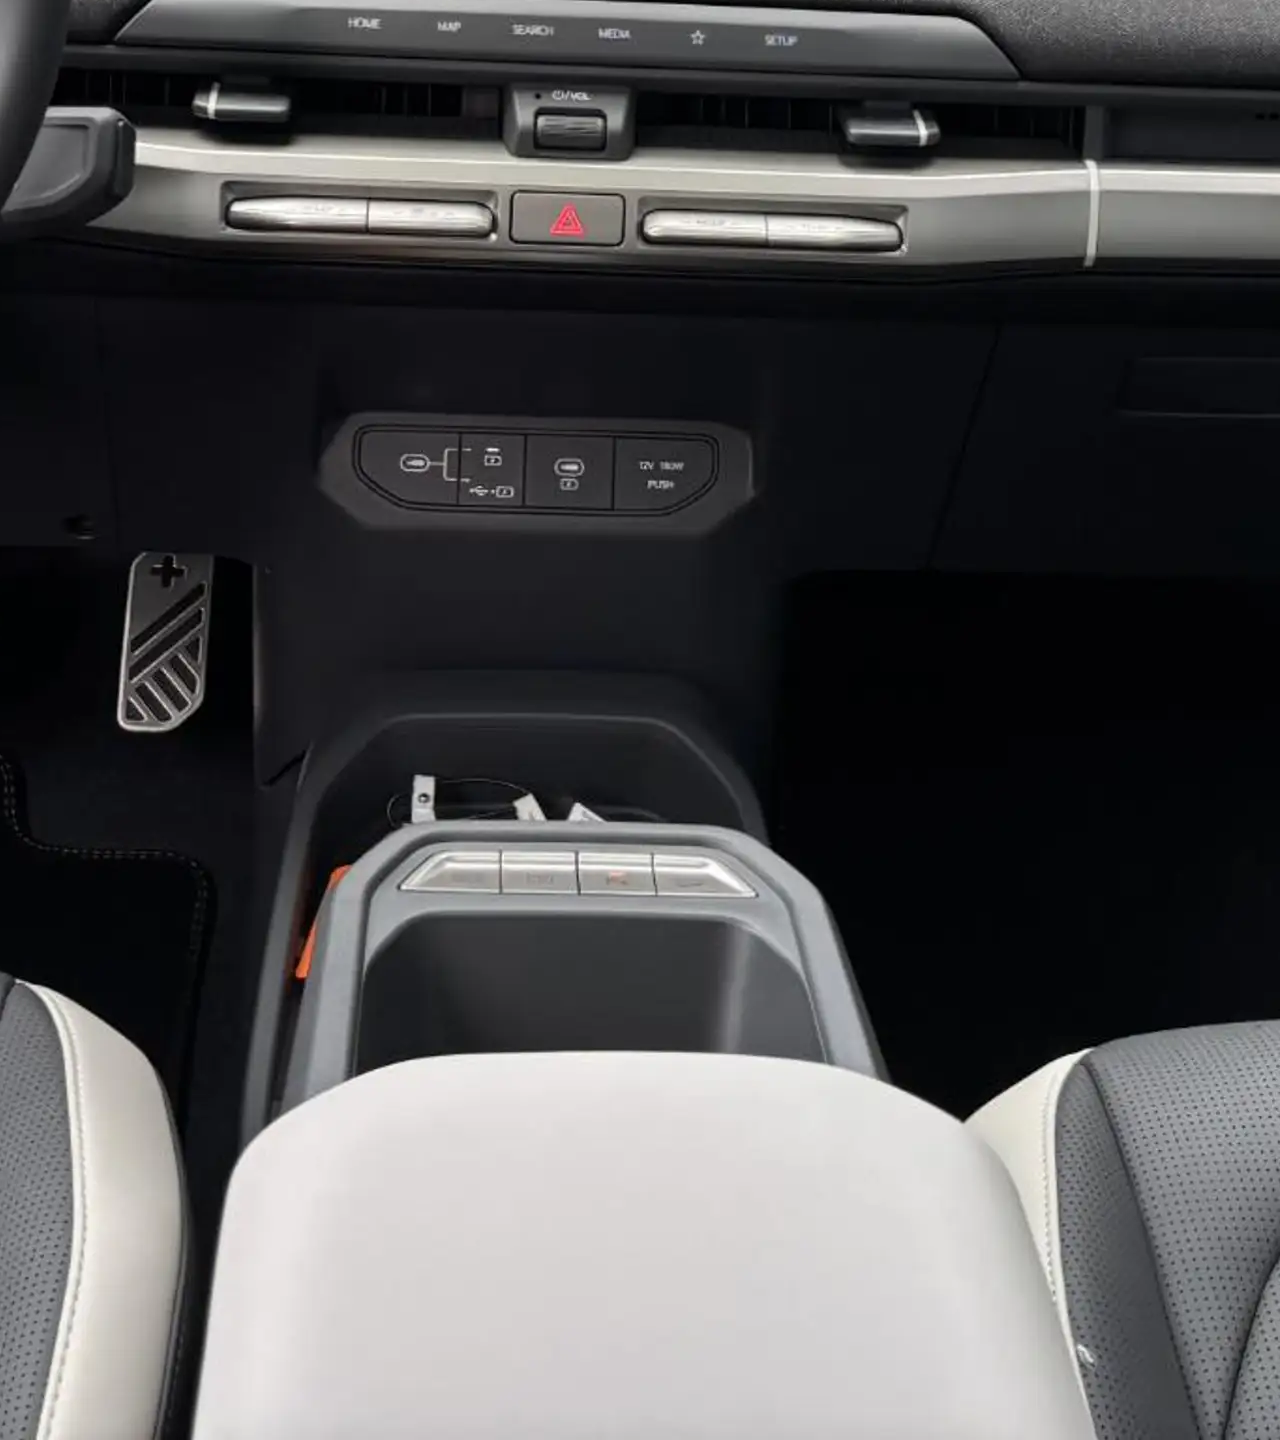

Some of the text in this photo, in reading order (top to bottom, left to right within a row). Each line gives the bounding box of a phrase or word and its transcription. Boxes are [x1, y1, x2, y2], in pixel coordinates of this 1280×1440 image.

[348, 16, 382, 30] HOME
[437, 20, 462, 33] MAP
[512, 24, 555, 37] SEARCH
[598, 28, 632, 40] MEDIA
[764, 34, 798, 47] SETUP
